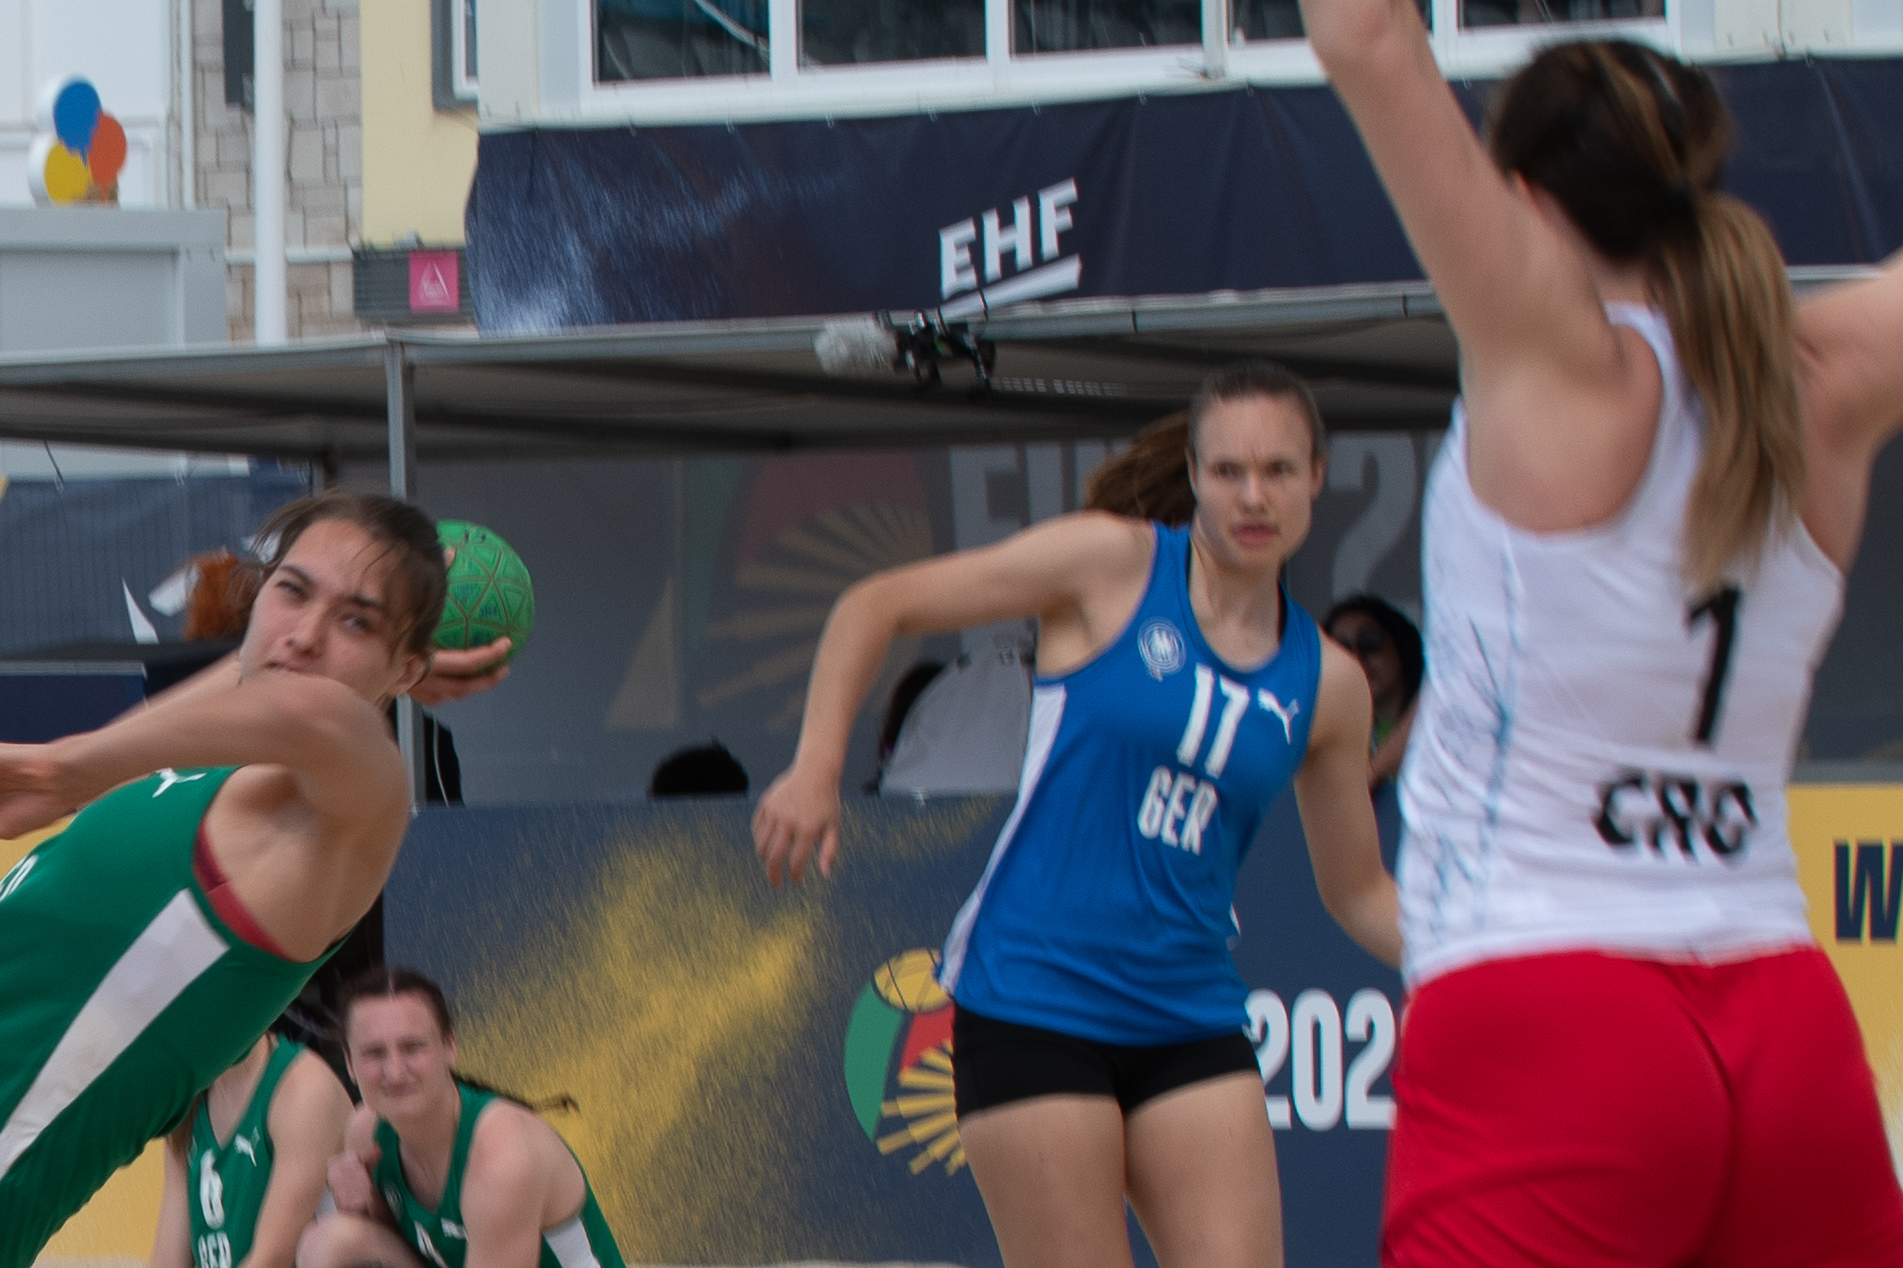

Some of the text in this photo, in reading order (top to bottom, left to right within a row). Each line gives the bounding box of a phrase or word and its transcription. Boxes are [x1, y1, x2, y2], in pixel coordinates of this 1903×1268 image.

[939, 178, 1078, 300] EHF
[1176, 663, 1249, 779] 17
[1683, 586, 1741, 747] 1
[1137, 765, 1218, 856] GER
[1592, 768, 1756, 867] CRO
[1242, 986, 1398, 1132] 202
[200, 1149, 225, 1230] 6
